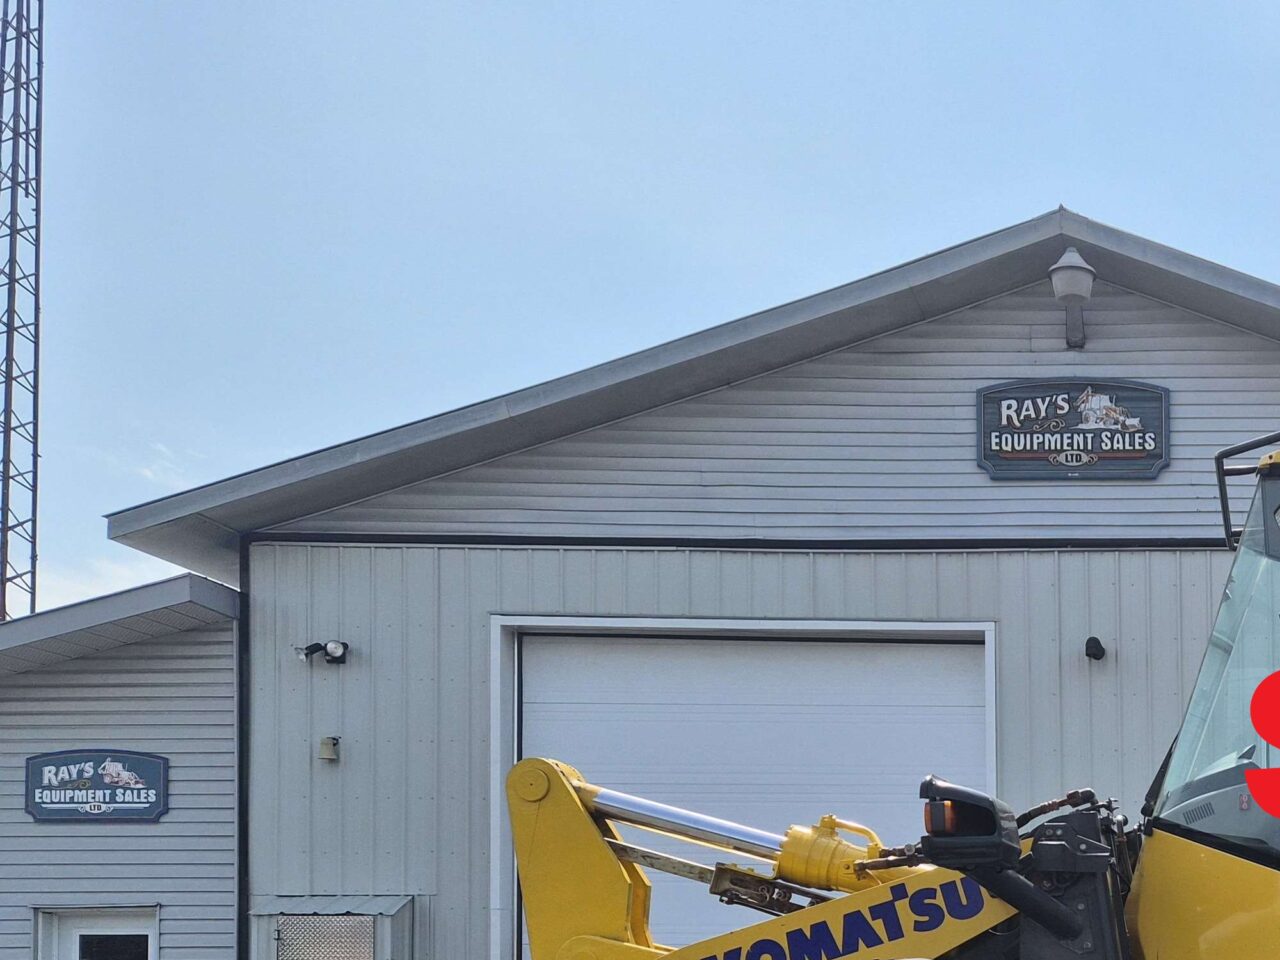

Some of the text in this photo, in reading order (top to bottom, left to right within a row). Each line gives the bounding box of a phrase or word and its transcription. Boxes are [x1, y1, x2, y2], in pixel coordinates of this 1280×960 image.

[1001, 394, 1070, 428] RAY'S
[990, 431, 1156, 452] EQUIPMENT SALES
[42, 762, 94, 787] RAY'S
[34, 788, 156, 803] EQUIPMENT SALES
